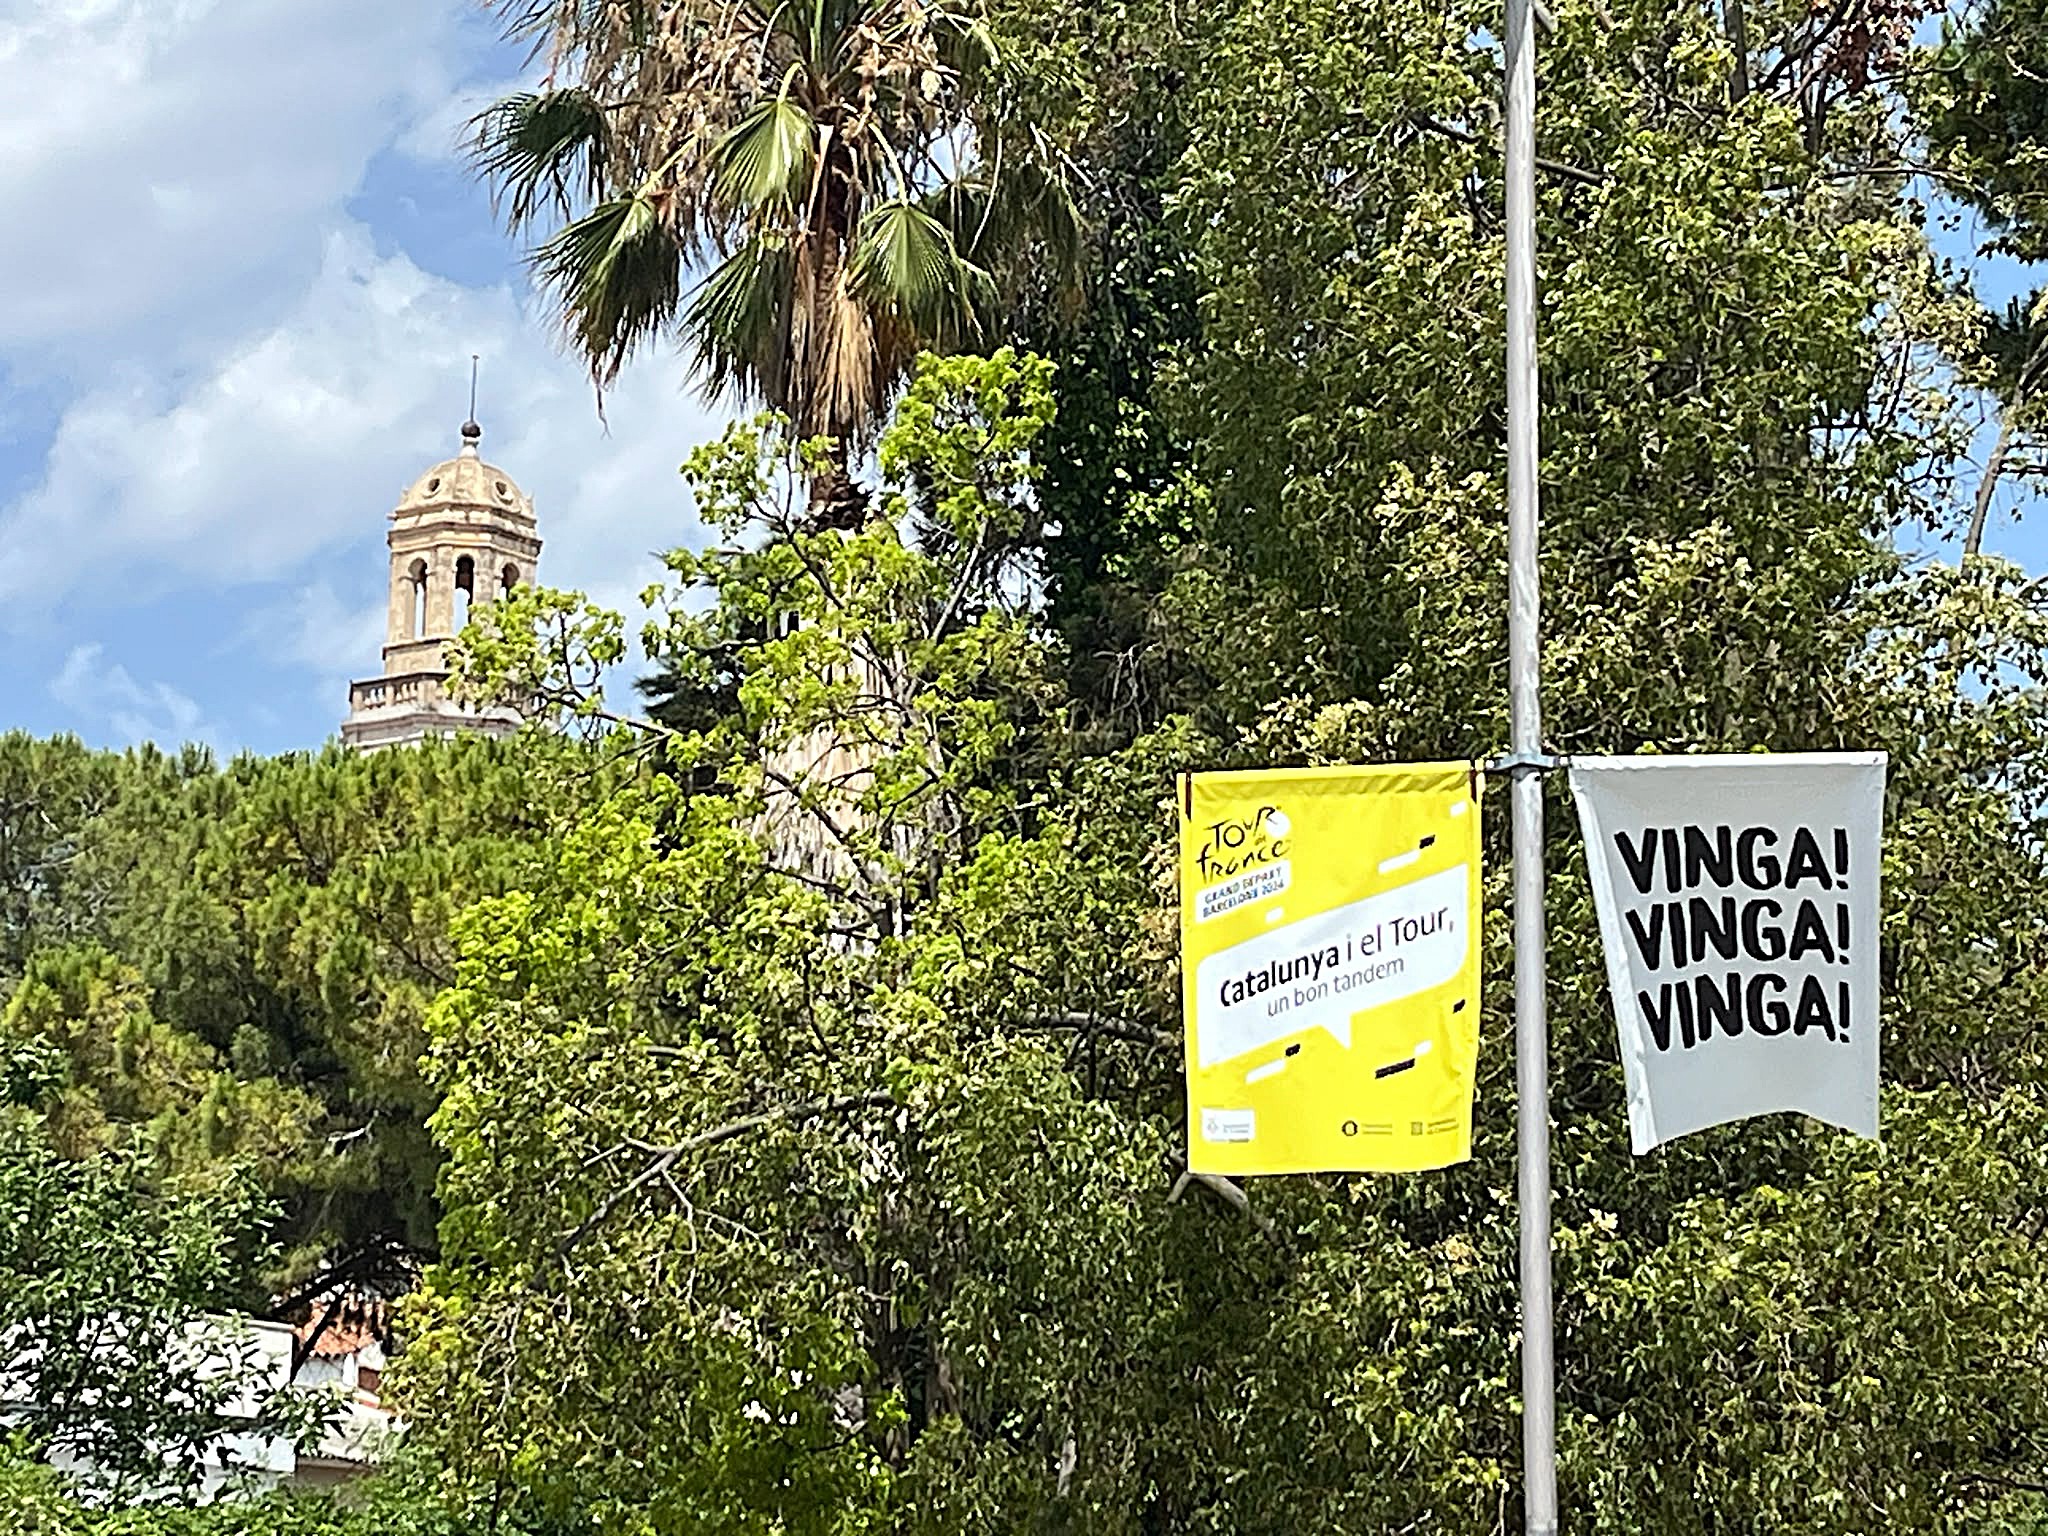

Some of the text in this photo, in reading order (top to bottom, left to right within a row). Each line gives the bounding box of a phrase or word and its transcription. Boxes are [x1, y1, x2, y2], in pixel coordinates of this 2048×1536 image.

[1204, 881, 1240, 905] GRAND
[1614, 825, 1849, 894] VINGA!
[1220, 907, 1454, 1007] Catalunya i el Tour,
[1625, 896, 1850, 971] VINGA!
[1267, 957, 1405, 1018] un bon tandem
[1638, 972, 1850, 1052] VINGA!
